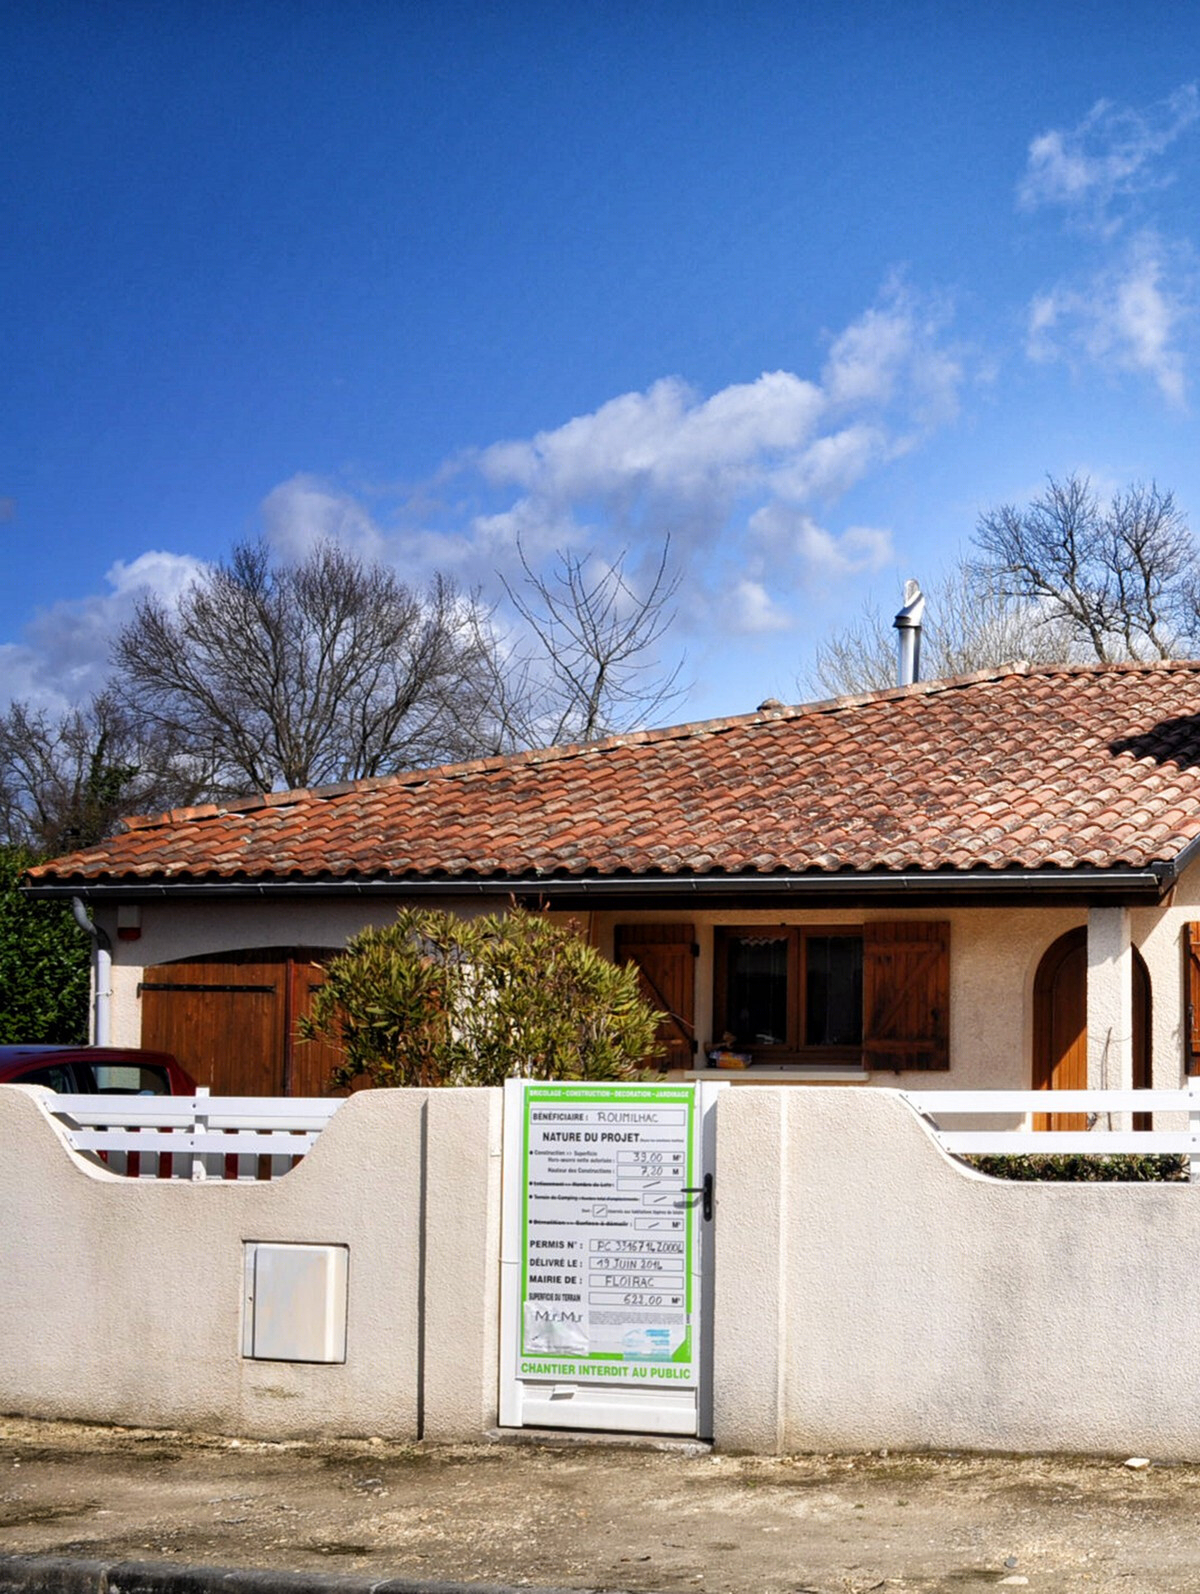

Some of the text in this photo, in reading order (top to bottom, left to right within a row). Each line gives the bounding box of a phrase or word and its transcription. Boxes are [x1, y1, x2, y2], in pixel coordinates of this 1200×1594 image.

[533, 1112, 584, 1120] BÉNÉFICIAIRE
[543, 1132, 582, 1142] NATURE
[584, 1132, 598, 1142] DU
[601, 1132, 640, 1142] PROJET
[530, 1240, 564, 1248] PERMIS
[530, 1256, 564, 1268] DÉLIVRÉ
[568, 1260, 578, 1268] LE
[613, 1258, 636, 1268] JUIN
[529, 1275, 562, 1284] MAIRIE
[564, 1276, 577, 1284] DE
[606, 1275, 654, 1288] FLOIRAC
[521, 1362, 690, 1379] CHANTIER INTERDIT AU PUBLIC
